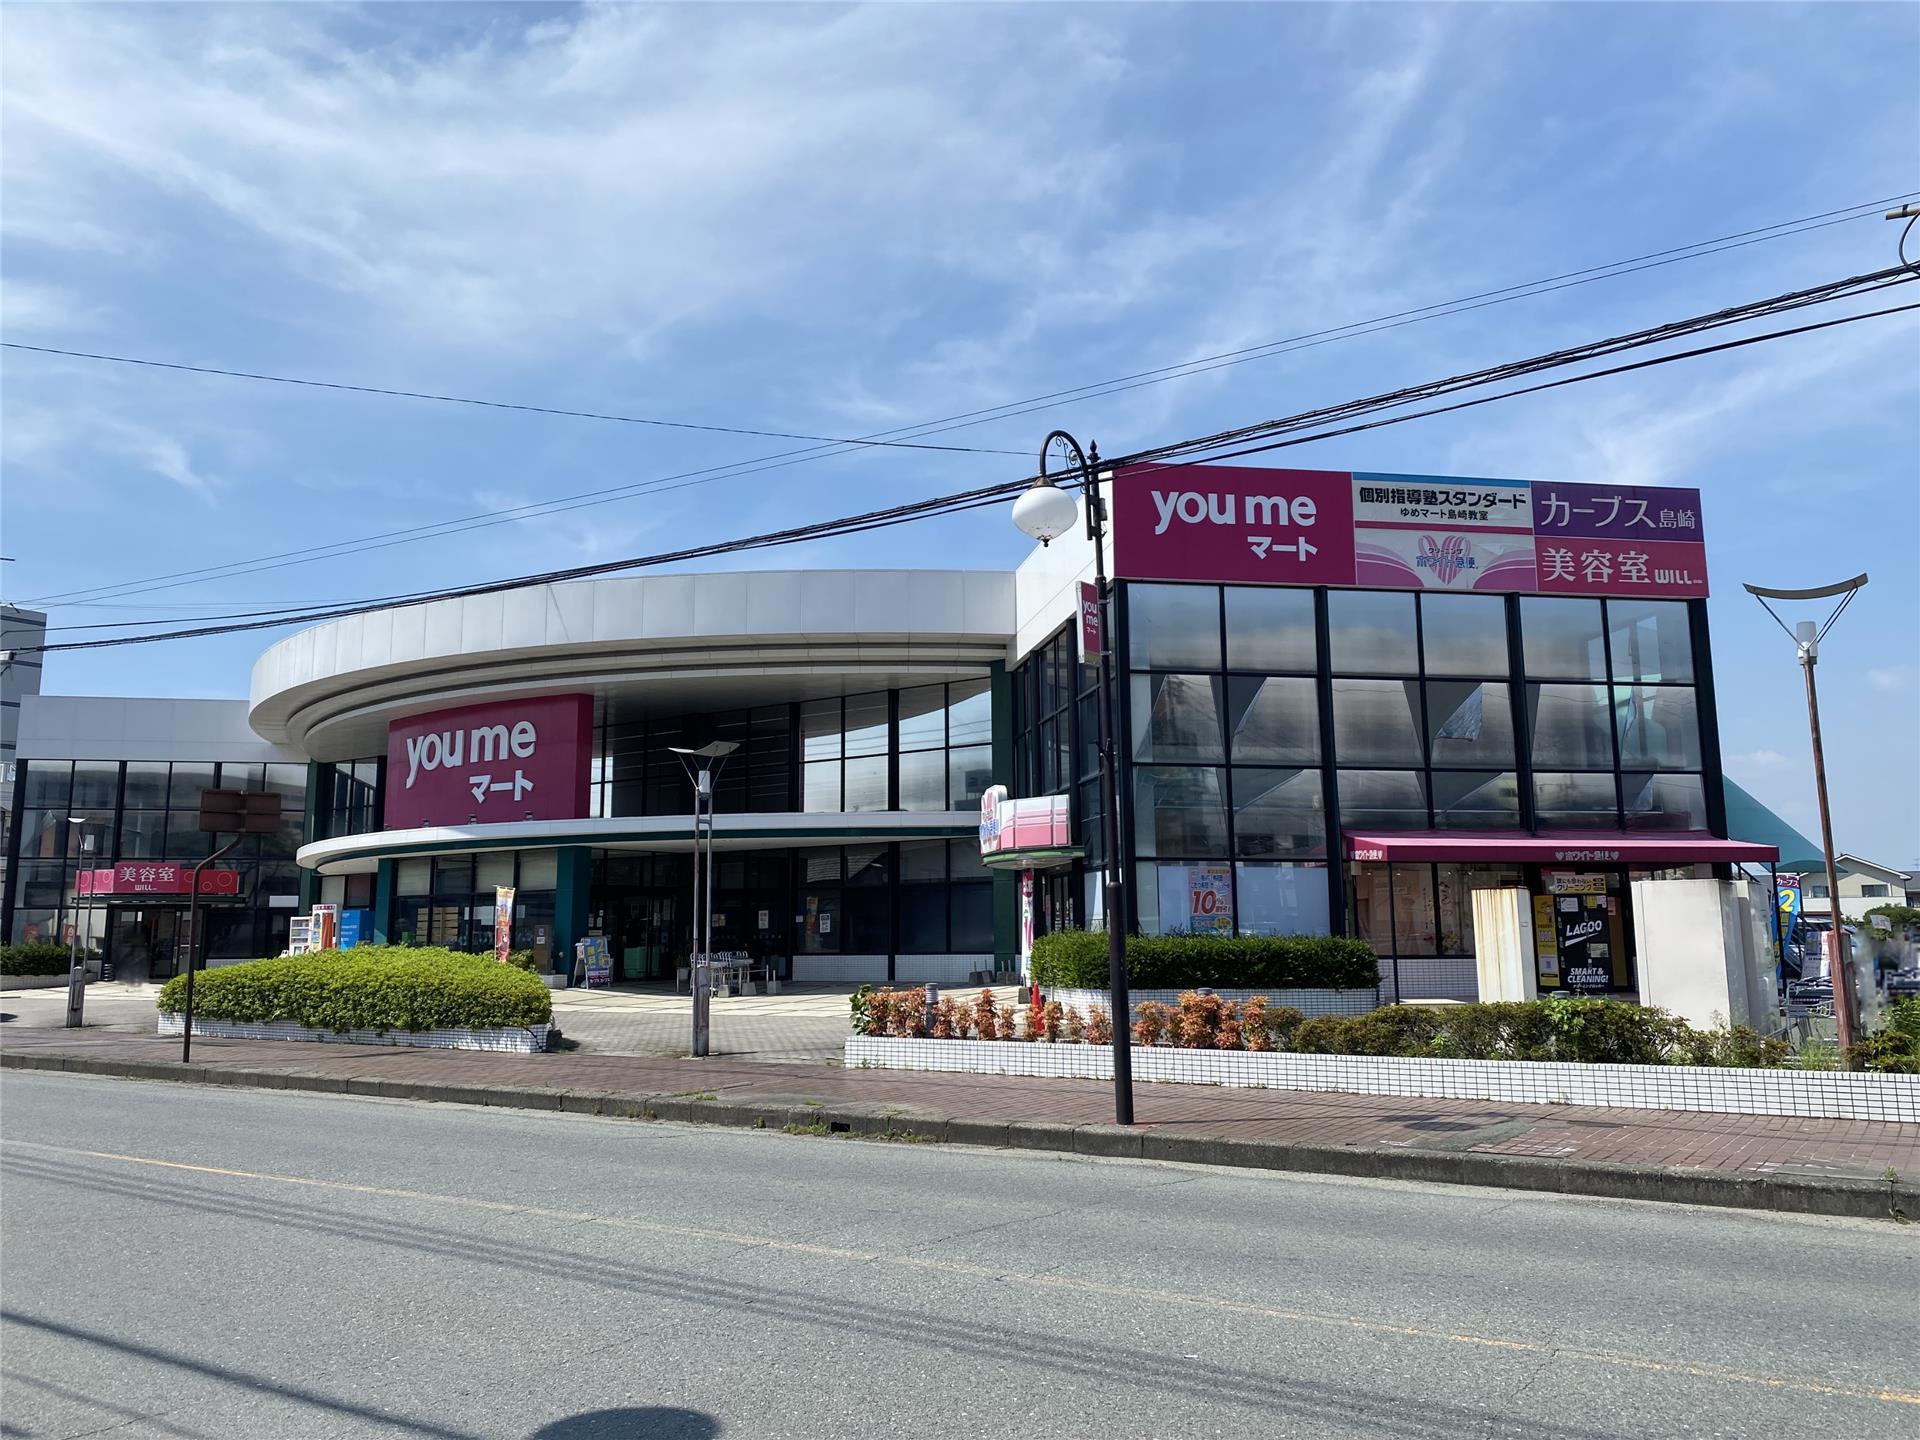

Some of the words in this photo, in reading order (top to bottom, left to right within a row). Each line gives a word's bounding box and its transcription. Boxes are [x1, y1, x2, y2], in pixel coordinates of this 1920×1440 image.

[1359, 486, 1526, 510] 個別指導塾スタンダード
[1151, 491, 1235, 535] you
[1245, 495, 1317, 527] me
[1400, 507, 1489, 521] ゆめマート島崎教室
[1541, 492, 1656, 528] カーブス
[1659, 508, 1696, 530] 島崎
[1247, 536, 1318, 562] マート
[1541, 547, 1651, 584] 美容室
[1654, 569, 1692, 585] WILL
[1083, 600, 1097, 614] you
[1086, 615, 1098, 627] me
[406, 729, 465, 789] you
[469, 720, 537, 763] me
[469, 769, 534, 804] マート
[120, 867, 175, 881] 美容室
[1779, 889, 1795, 912] 2
[1565, 920, 1602, 937] LAGOO
[1567, 975, 1609, 983] CLEANING!
